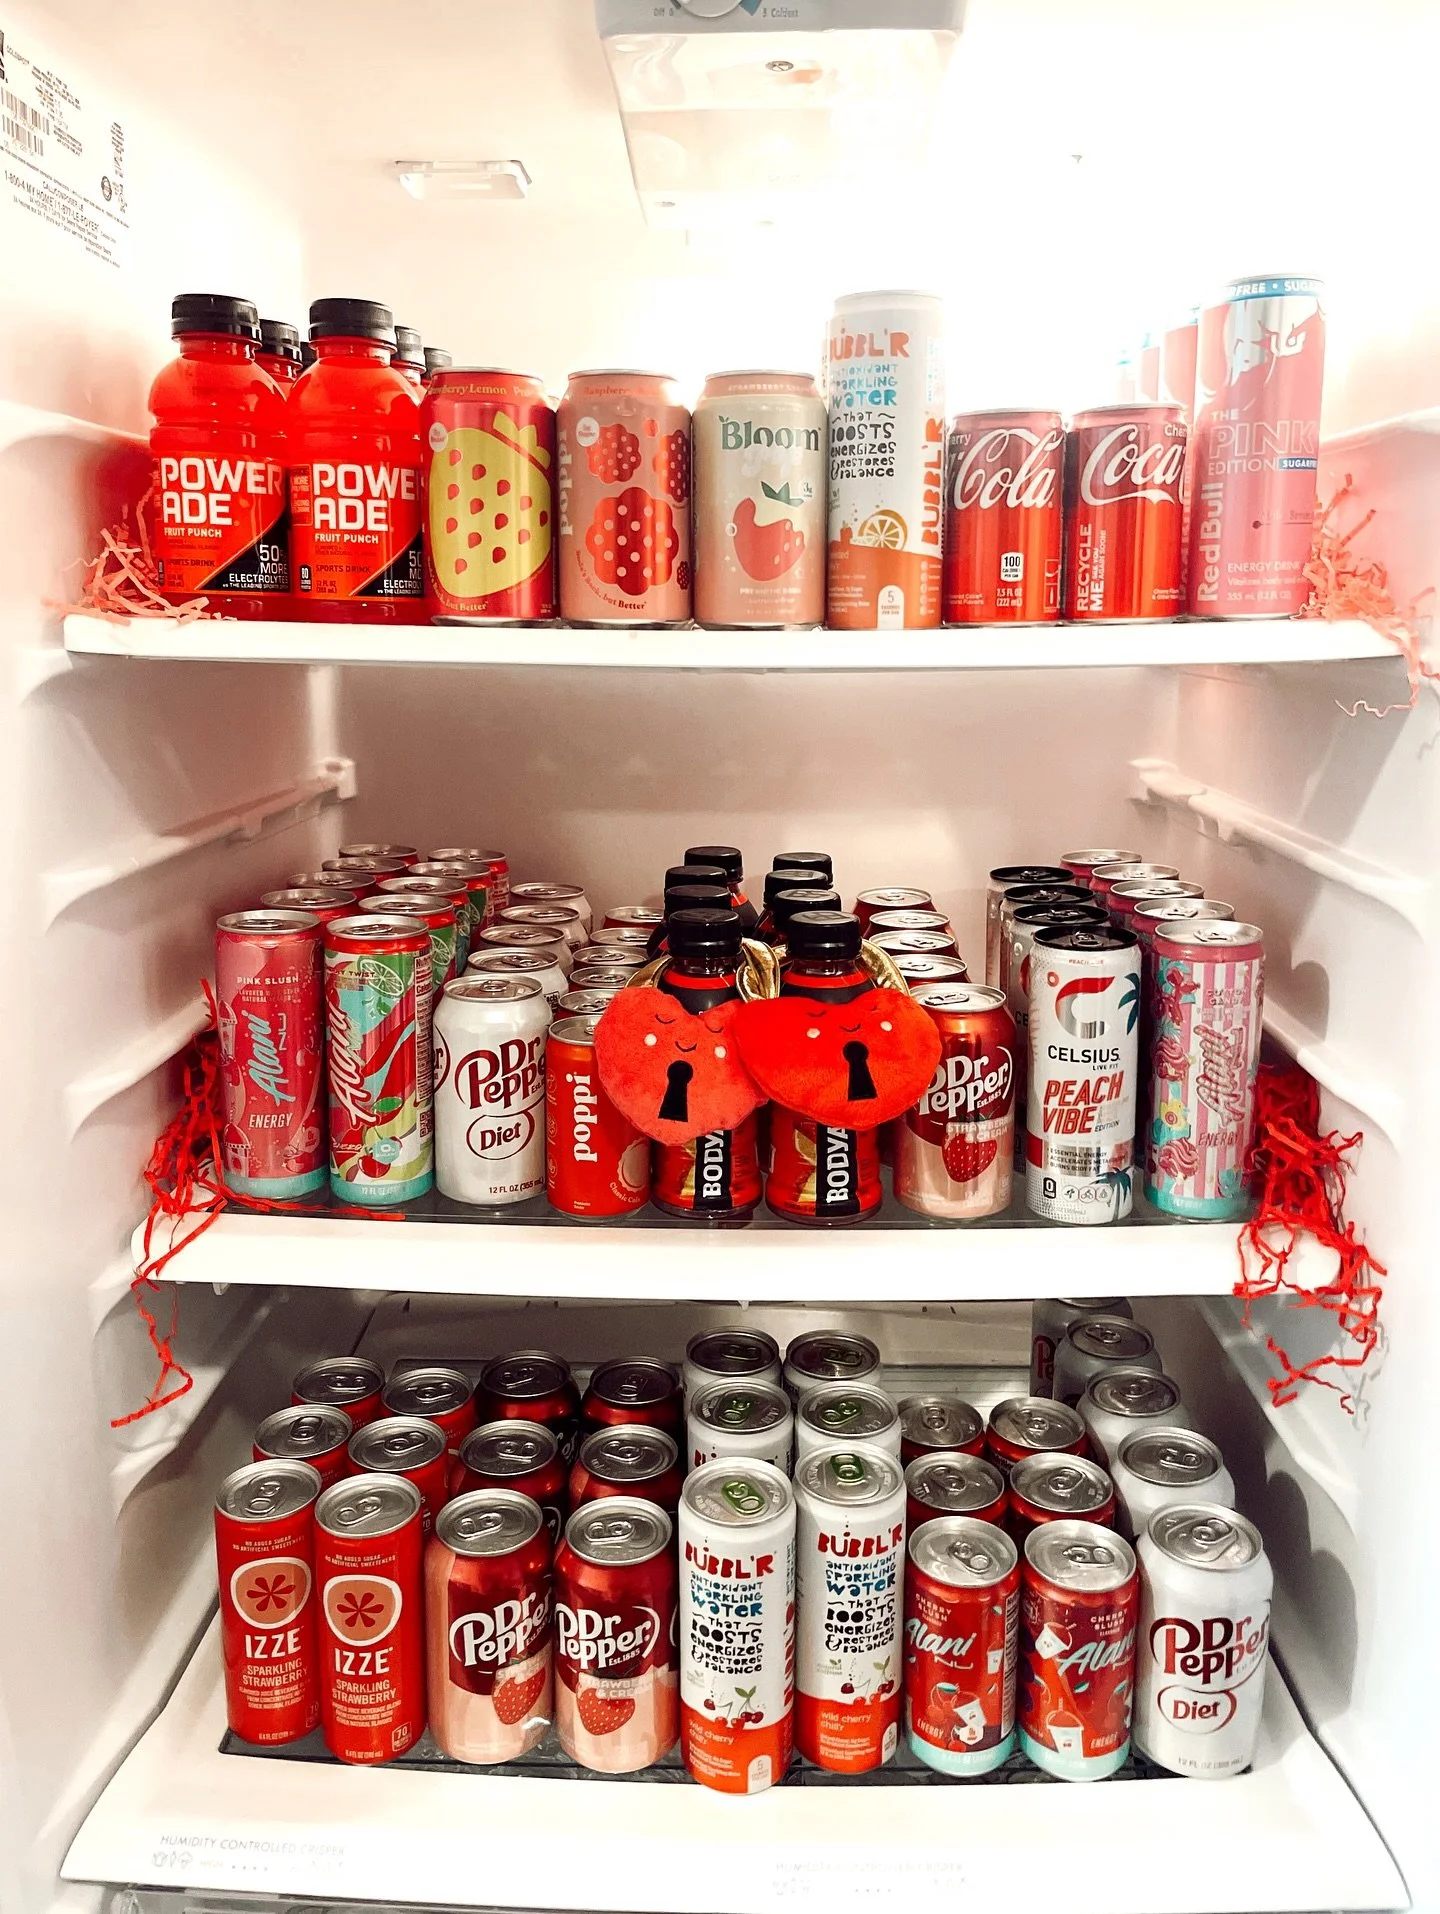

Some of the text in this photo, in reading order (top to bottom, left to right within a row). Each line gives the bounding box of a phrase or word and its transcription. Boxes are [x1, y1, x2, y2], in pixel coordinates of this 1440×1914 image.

[1210, 408, 1239, 421] THE
[721, 416, 820, 452] Bloom
[1207, 420, 1318, 459] PINK
[954, 428, 1064, 510] Cola
[1080, 424, 1185, 506] Coca
[1207, 456, 1276, 477] EDITION
[160, 457, 283, 497] POWER
[312, 463, 418, 501] POWE
[162, 491, 233, 526] ADE
[314, 497, 389, 532] ADE
[164, 527, 223, 538] FRUIT PUNCH
[314, 533, 379, 544] FRUIT PUNCH
[1197, 482, 1224, 601] Bull Red
[259, 562, 289, 575] MORE
[1003, 556, 1021, 567] 100
[1076, 523, 1092, 612] RECYCLE
[1227, 562, 1271, 573] ENERGY
[229, 573, 289, 584] ELECTROLYTES
[1089, 580, 1104, 612] ME
[237, 976, 299, 985] PINK SLUSH
[241, 1010, 296, 1107] Alani
[499, 1036, 541, 1078] Dr
[1047, 1045, 1119, 1063] CELSIUS
[946, 1054, 989, 1090] Dr
[1044, 1071, 1124, 1107] PEACH
[249, 1112, 293, 1129] ENERGY
[566, 1072, 597, 1162] poppi
[1043, 1105, 1097, 1134] VIBE
[1094, 1120, 1120, 1132] EDITION
[480, 1121, 523, 1151] Diet
[1198, 1132, 1239, 1147] ENERGY
[489, 1186, 498, 1194] 12
[499, 1186, 508, 1194] FL
[508, 1184, 519, 1193] OZ
[494, 1591, 536, 1637] Dr
[915, 1593, 952, 1614] CHERRY
[918, 1602, 948, 1622] SLUSH
[577, 1609, 621, 1642] Dr
[1090, 1609, 1127, 1623] CHERRY
[1094, 1619, 1125, 1630] SLUSH
[245, 1628, 302, 1659] IZZE
[555, 1603, 652, 1670] Pepper
[906, 1617, 977, 1657] Alani
[1201, 1616, 1252, 1652] Dr
[608, 1648, 641, 1667] Est.1885
[1149, 1613, 1270, 1685] Pepper
[246, 1657, 303, 1676] SPARKLING
[334, 1647, 390, 1676] IZZE
[242, 1665, 308, 1687] STRAWBERRY
[336, 1679, 390, 1693] SPARKLING
[332, 1688, 397, 1705] STRAWBERRY
[841, 1714, 872, 1724] cherry
[1173, 1699, 1221, 1720] Diet
[396, 1726, 408, 1739] 70
[704, 1731, 735, 1746] cherry
[917, 1717, 945, 1739] ENERGY
[160, 1835, 217, 1848] HUMIDITY
[219, 1838, 297, 1854] CONTROLLED
